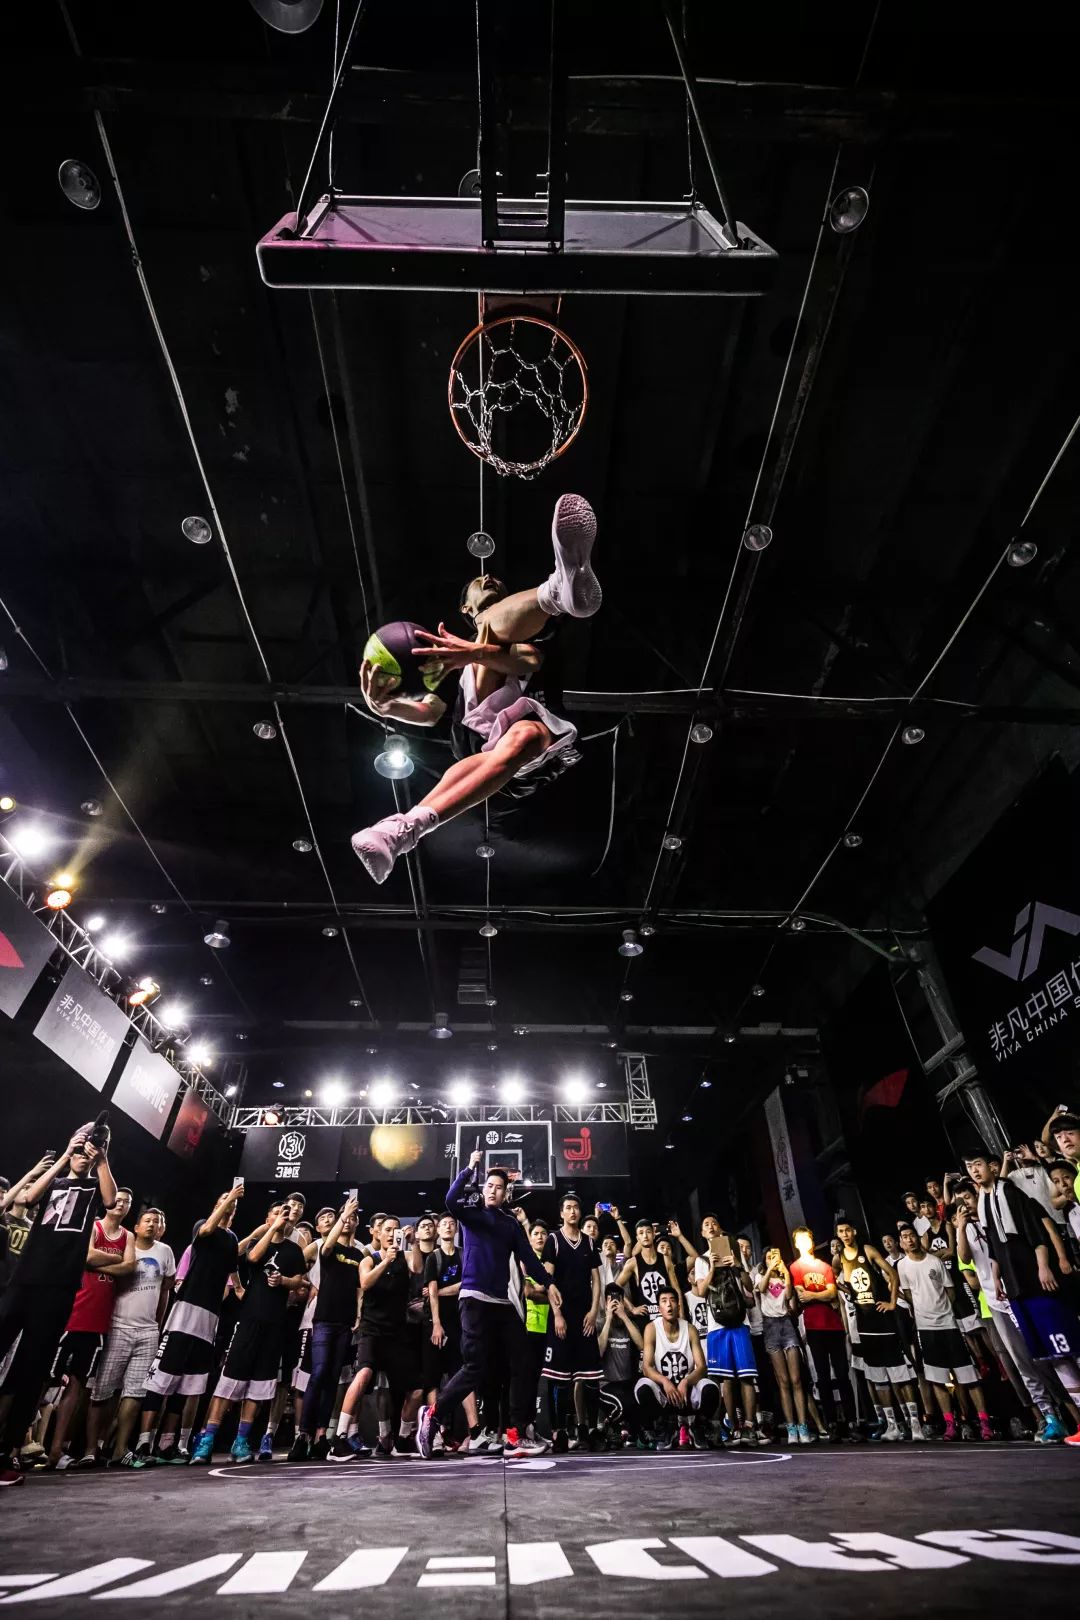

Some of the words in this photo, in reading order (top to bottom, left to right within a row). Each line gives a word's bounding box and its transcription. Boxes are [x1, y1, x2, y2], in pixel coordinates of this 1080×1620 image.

[995, 1040, 1022, 1062] VIVA
[1026, 1007, 1068, 1042] CHINA
[1049, 1333, 1070, 1353] 13
